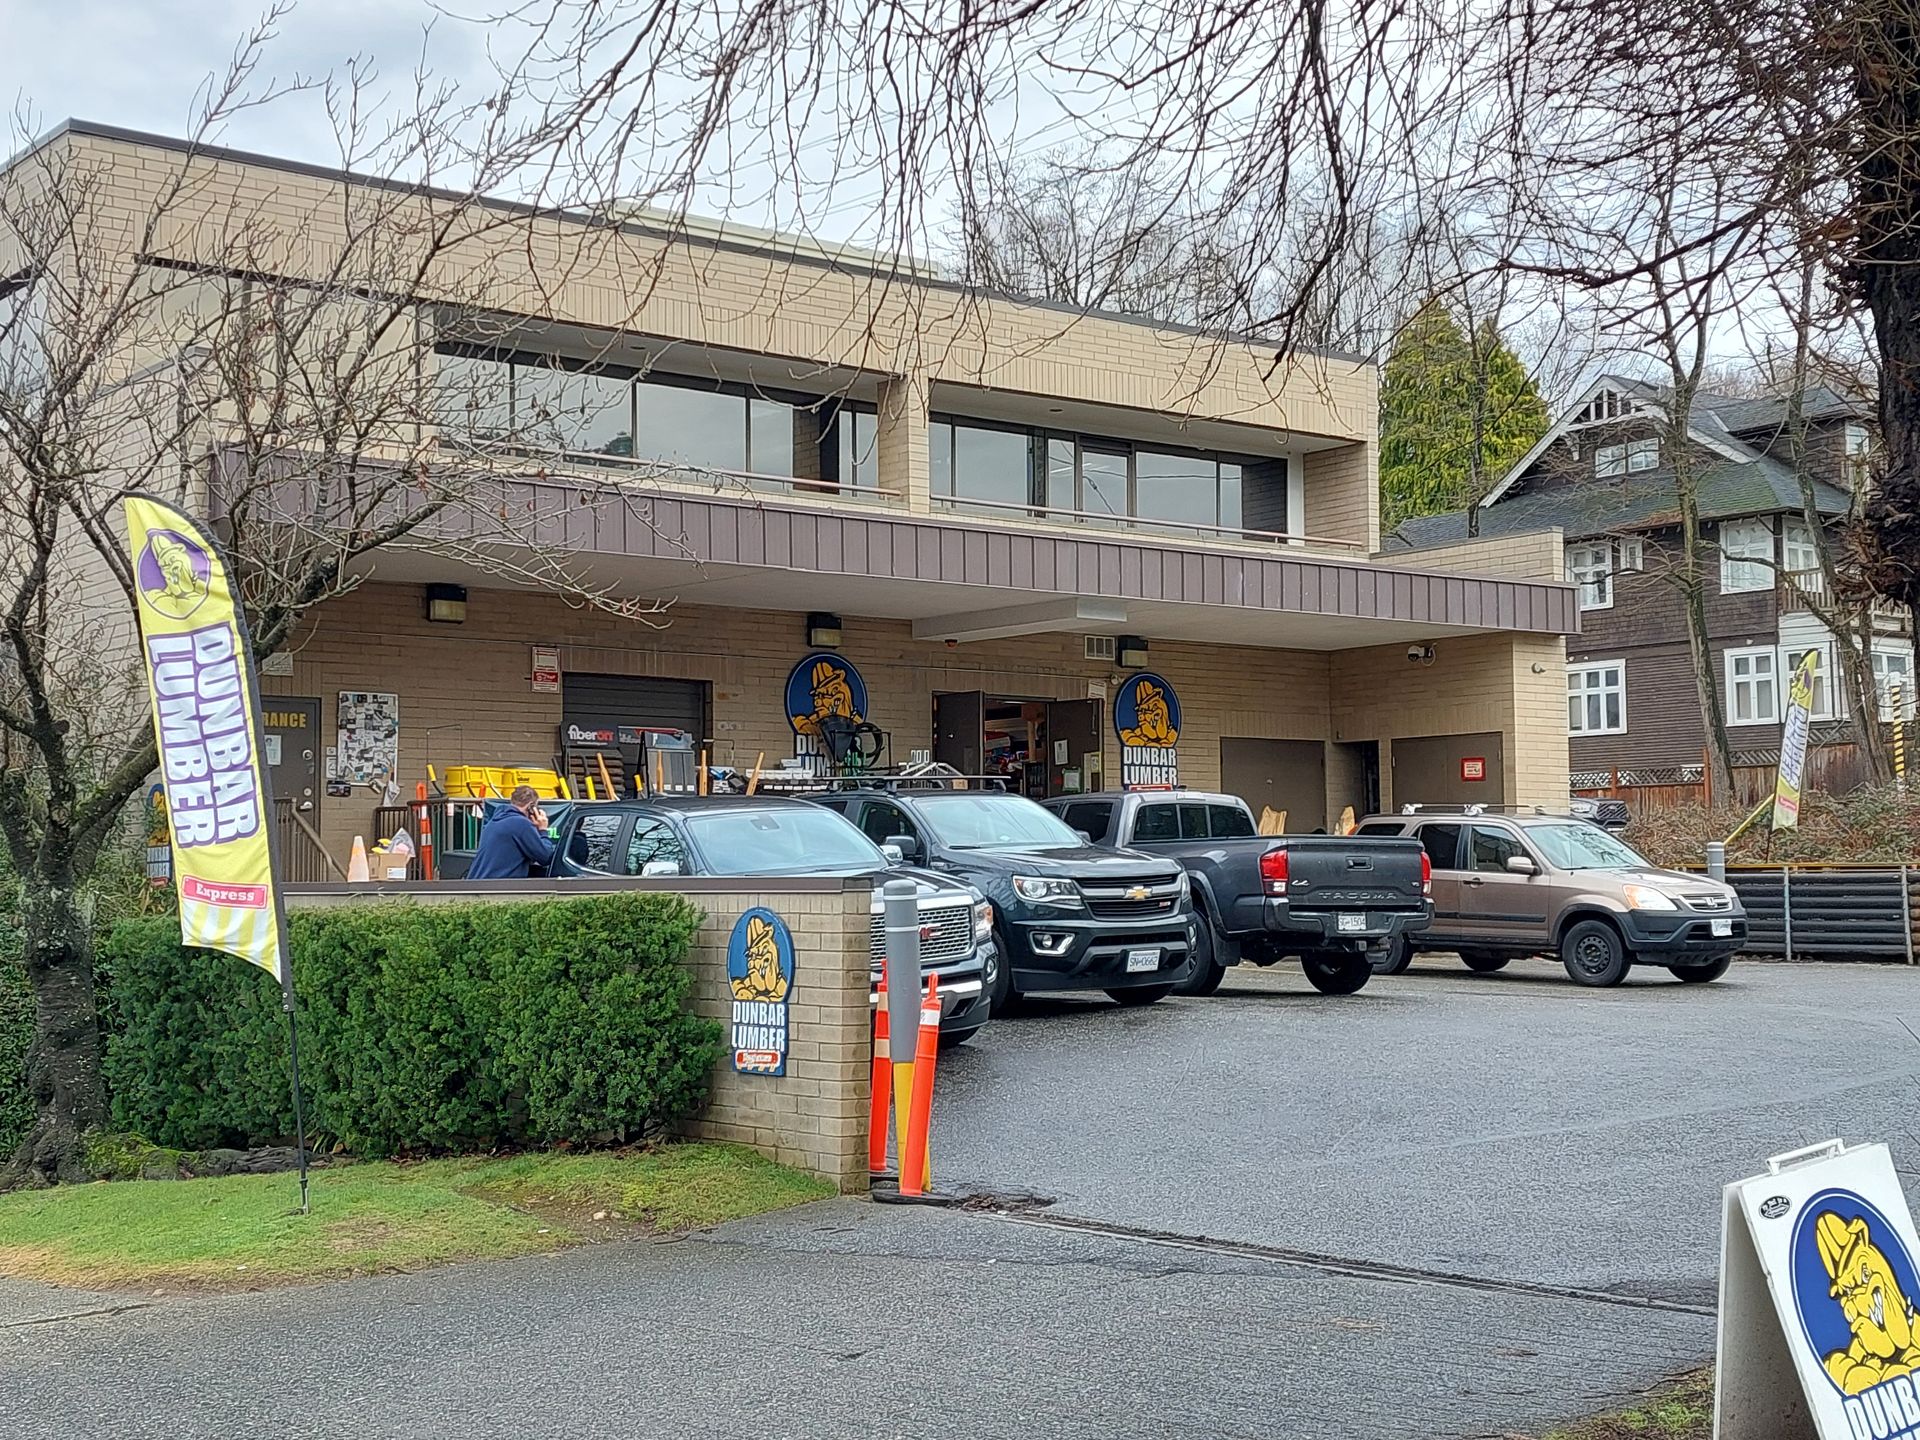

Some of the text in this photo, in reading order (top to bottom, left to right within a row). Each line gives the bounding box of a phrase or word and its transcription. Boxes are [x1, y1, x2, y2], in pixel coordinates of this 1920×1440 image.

[262, 712, 308, 729] RANCE
[148, 635, 215, 844] LUMBER
[192, 626, 258, 839] DUNBAR
[567, 724, 614, 742] fiberon
[796, 734, 862, 756] DUR
[1123, 746, 1177, 766] DUNBAR
[1123, 765, 1177, 786] LUMBER
[195, 882, 256, 902] Express
[1318, 891, 1397, 900] TACOMA
[732, 1001, 786, 1027] DUNBAR
[731, 1025, 786, 1052] LUMBER
[1843, 1371, 1920, 1440] DUNB
